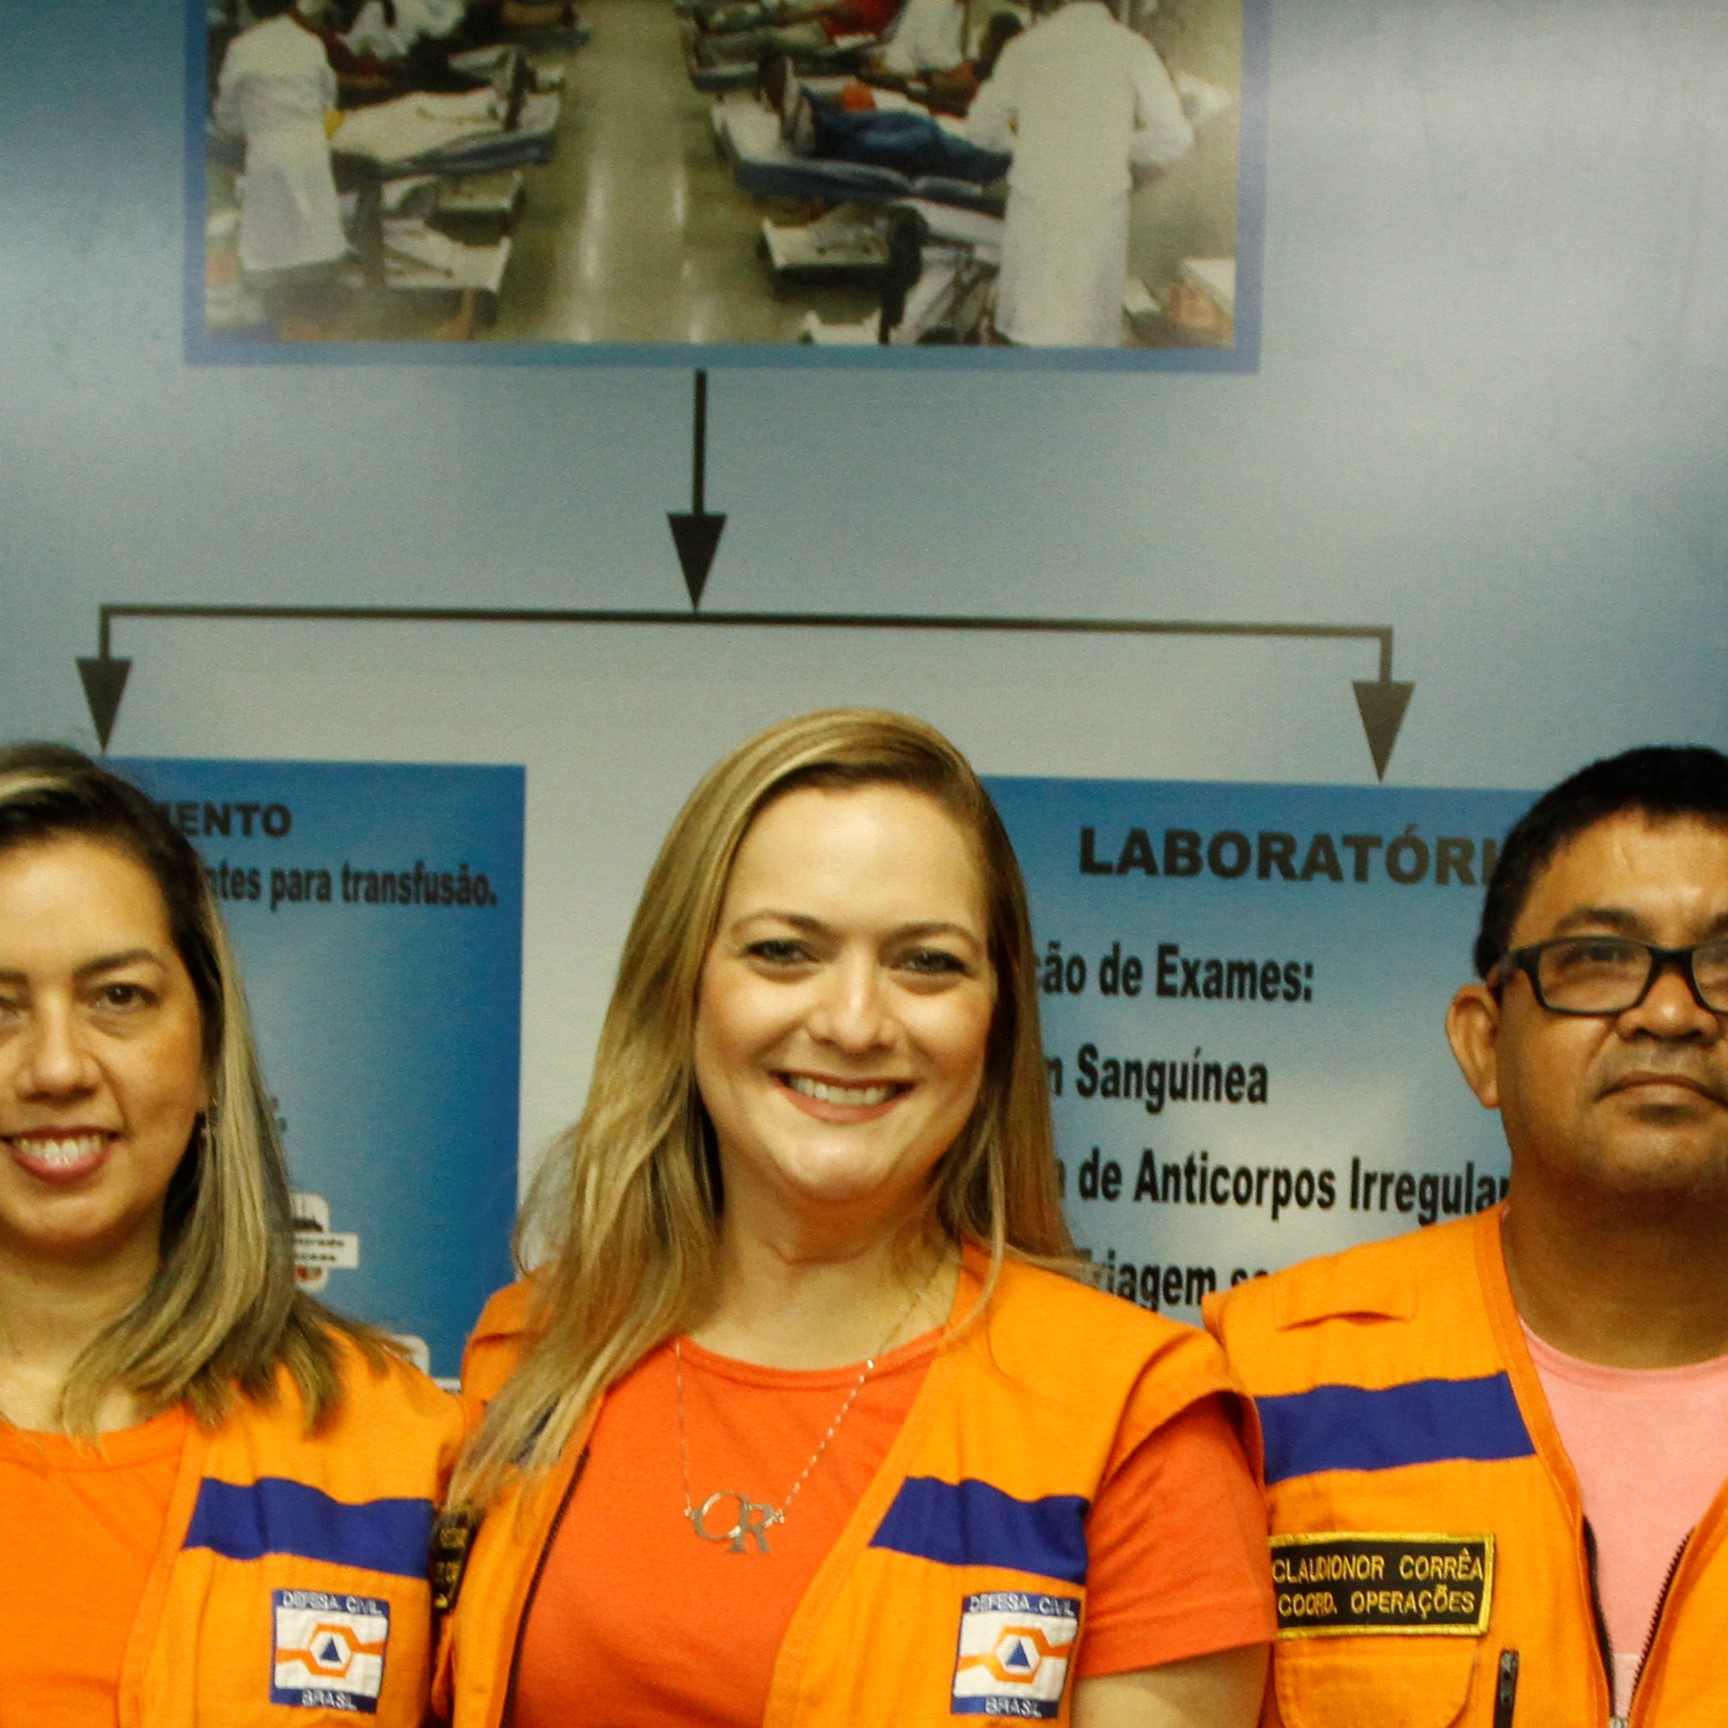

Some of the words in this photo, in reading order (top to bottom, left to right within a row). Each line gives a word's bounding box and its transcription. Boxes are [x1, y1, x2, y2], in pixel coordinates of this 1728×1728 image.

[270, 867, 332, 912] para
[342, 860, 498, 907] transfusão.
[1099, 942, 1143, 996] de
[1156, 943, 1314, 1001] Exames:
[1076, 1043, 1269, 1114] Sanguínea
[1079, 1146, 1122, 1201] de
[1134, 1148, 1336, 1221] Anticorpos
[1076, 1249, 1218, 1312] iagem
[1272, 1554, 1385, 1583] CLAUDIONOR
[1399, 1547, 1484, 1581] CORRÊA
[1350, 1583, 1475, 1620] OPERAÇÕES
